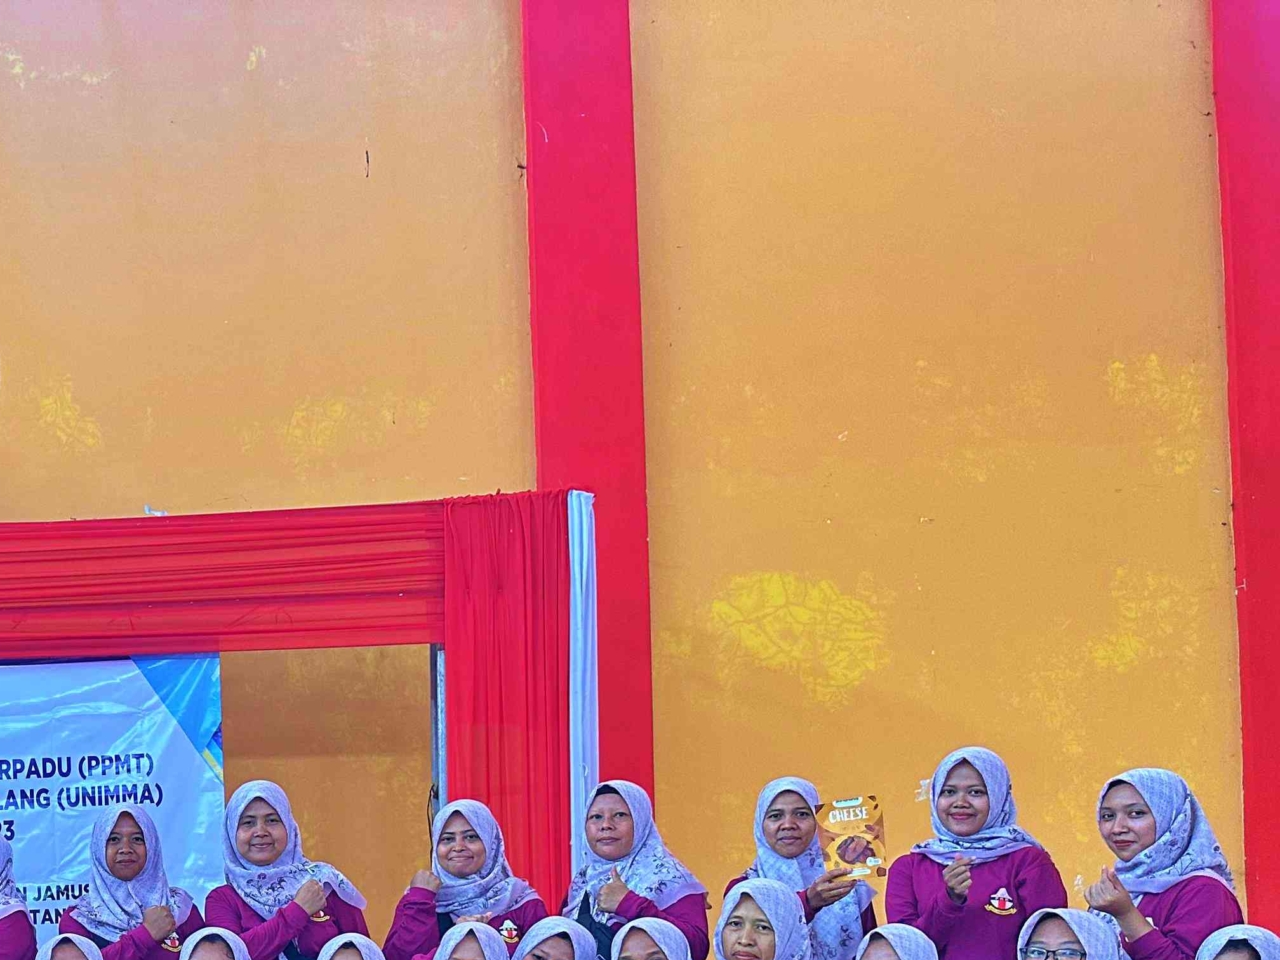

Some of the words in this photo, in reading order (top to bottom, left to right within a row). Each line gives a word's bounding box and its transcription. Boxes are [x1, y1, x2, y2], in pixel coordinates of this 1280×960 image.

[79, 753, 154, 780] (PPMT)
[57, 783, 163, 811] (UNIMMA)
[829, 807, 869, 824] CHEESE
